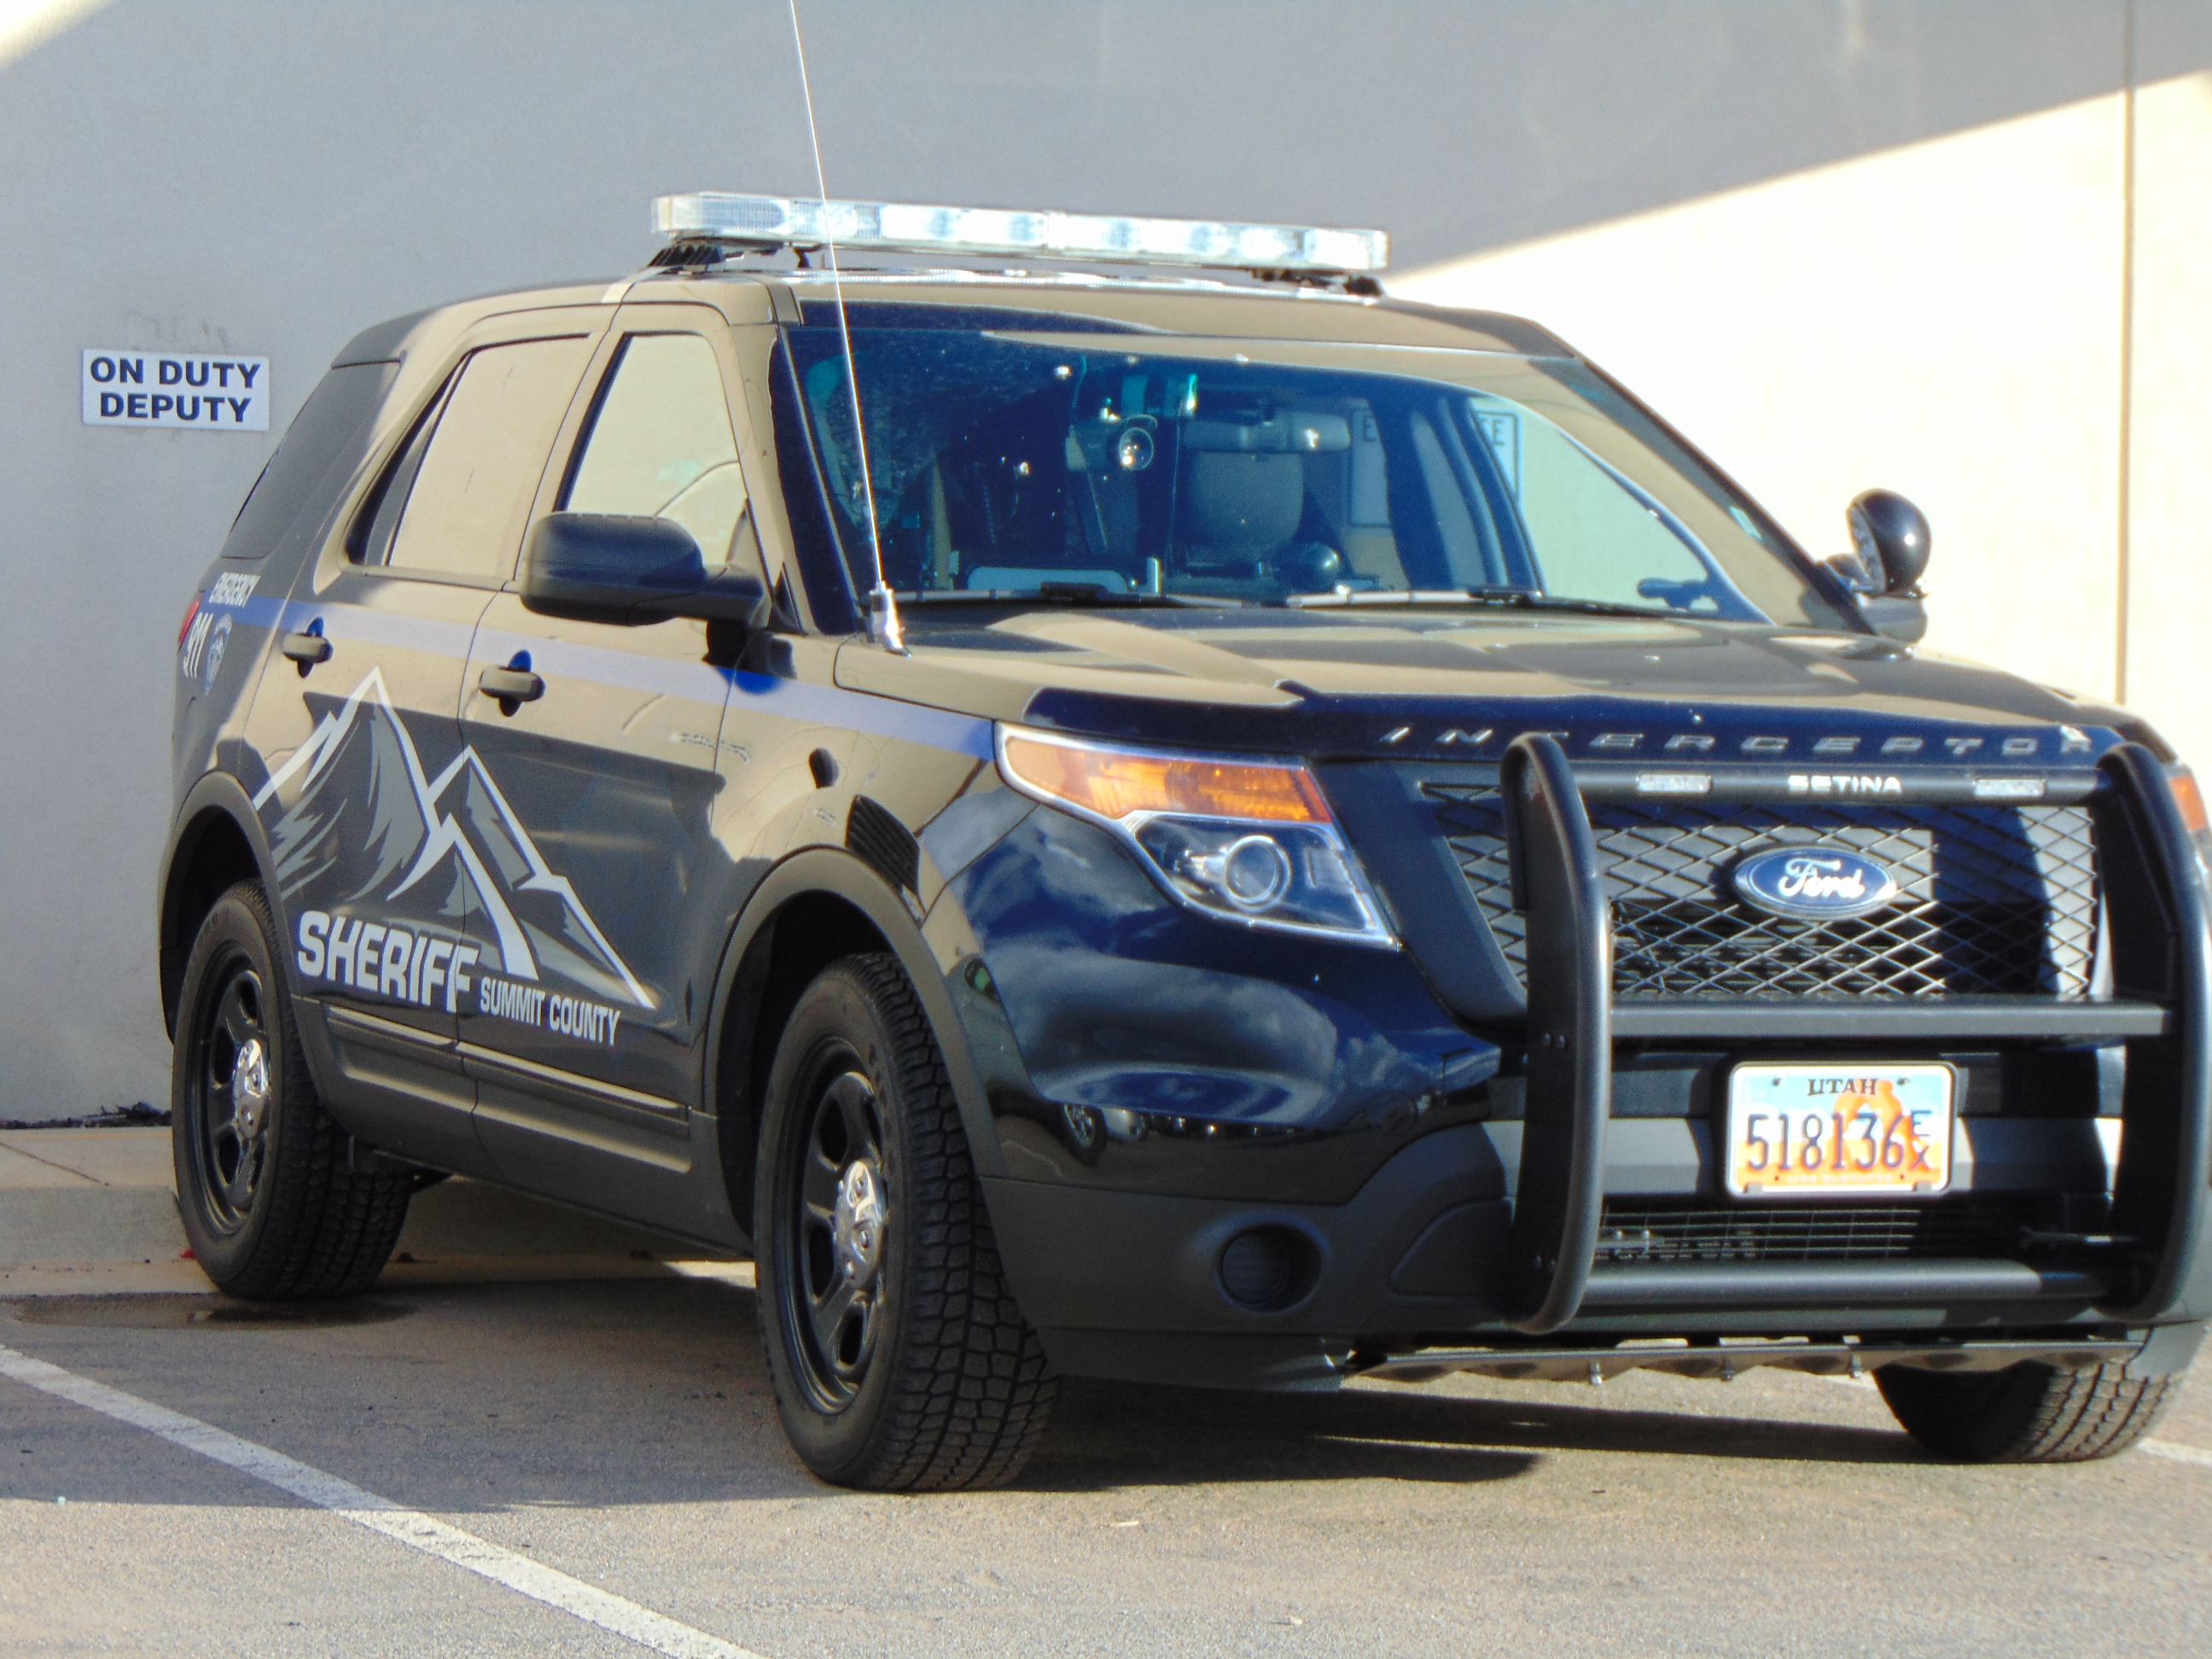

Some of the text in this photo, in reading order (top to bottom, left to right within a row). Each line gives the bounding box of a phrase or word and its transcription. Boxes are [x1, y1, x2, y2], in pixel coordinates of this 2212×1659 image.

[90, 357, 260, 389] ON DUTY
[101, 392, 252, 422] DEPUTY
[1788, 775, 1903, 795] SETINA
[1778, 858, 1866, 899] Ford
[298, 910, 621, 1046] SHERIFF SUMMIT COUNTY
[1807, 1079, 1878, 1097] UTAH
[1747, 1113, 1905, 1170] 518136
